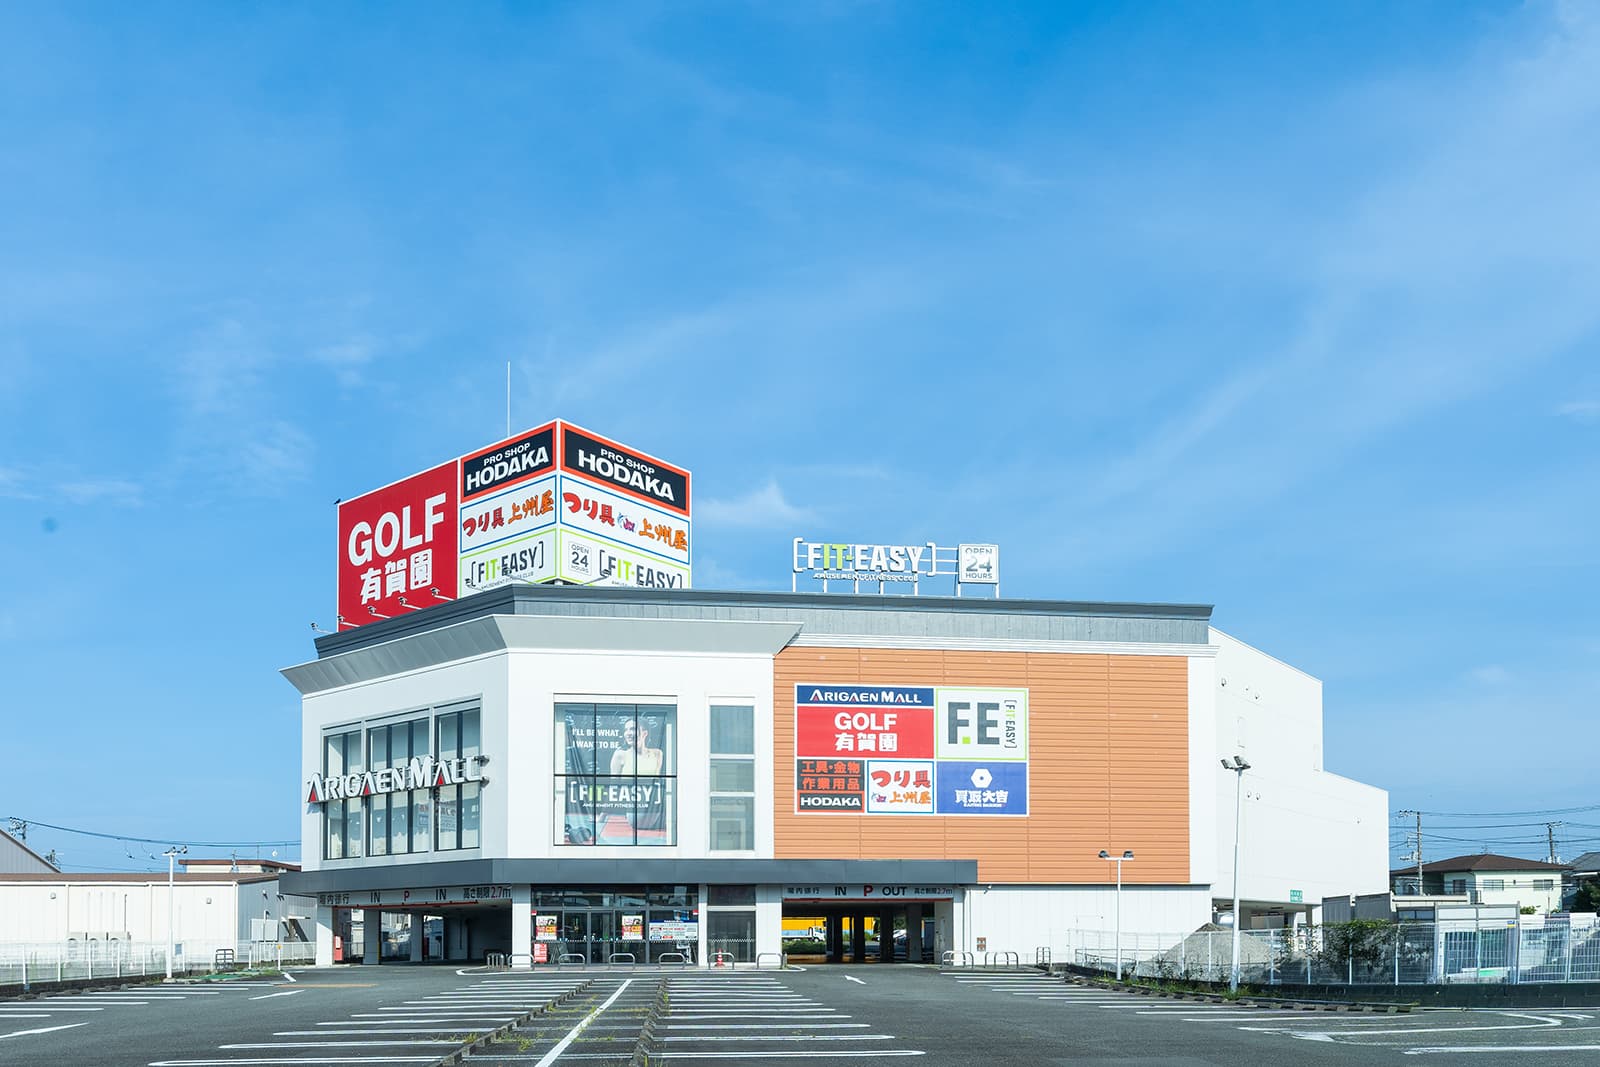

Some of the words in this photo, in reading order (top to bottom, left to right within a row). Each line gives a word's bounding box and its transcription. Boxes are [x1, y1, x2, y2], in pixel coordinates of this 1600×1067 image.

[483, 452, 503, 467] PRO
[504, 442, 531, 460] SHOP
[600, 448, 624, 464] PRO
[625, 456, 655, 475] SHOP
[466, 446, 549, 492] HODAKA
[577, 449, 675, 502] HODAKA
[462, 506, 505, 538] つり具
[507, 489, 555, 526] 上州屋
[562, 492, 616, 528] つり具
[638, 517, 688, 553] 上州屋
[348, 492, 447, 567] GOLF
[570, 544, 589, 555] OPEN
[571, 551, 589, 568] 24
[966, 556, 993, 572] 24
[360, 548, 433, 605] 有賀園
[809, 689, 879, 703] ARIGAEN
[881, 690, 922, 704] MALL
[834, 712, 898, 731] GOLF
[599, 741, 609, 749] TO
[835, 732, 898, 752] 有賀園
[306, 766, 406, 803] ARIGAEN
[410, 755, 483, 790] MALL
[802, 777, 861, 790] 作業用品
[870, 769, 932, 788] つり具
[800, 796, 862, 807] HODAKA
[889, 790, 932, 805] 上州屋
[370, 891, 381, 903] IN
[403, 890, 410, 902] P
[435, 888, 447, 901] IN
[834, 886, 847, 896] IN
[863, 885, 874, 897] P
[882, 886, 908, 896] OUT
